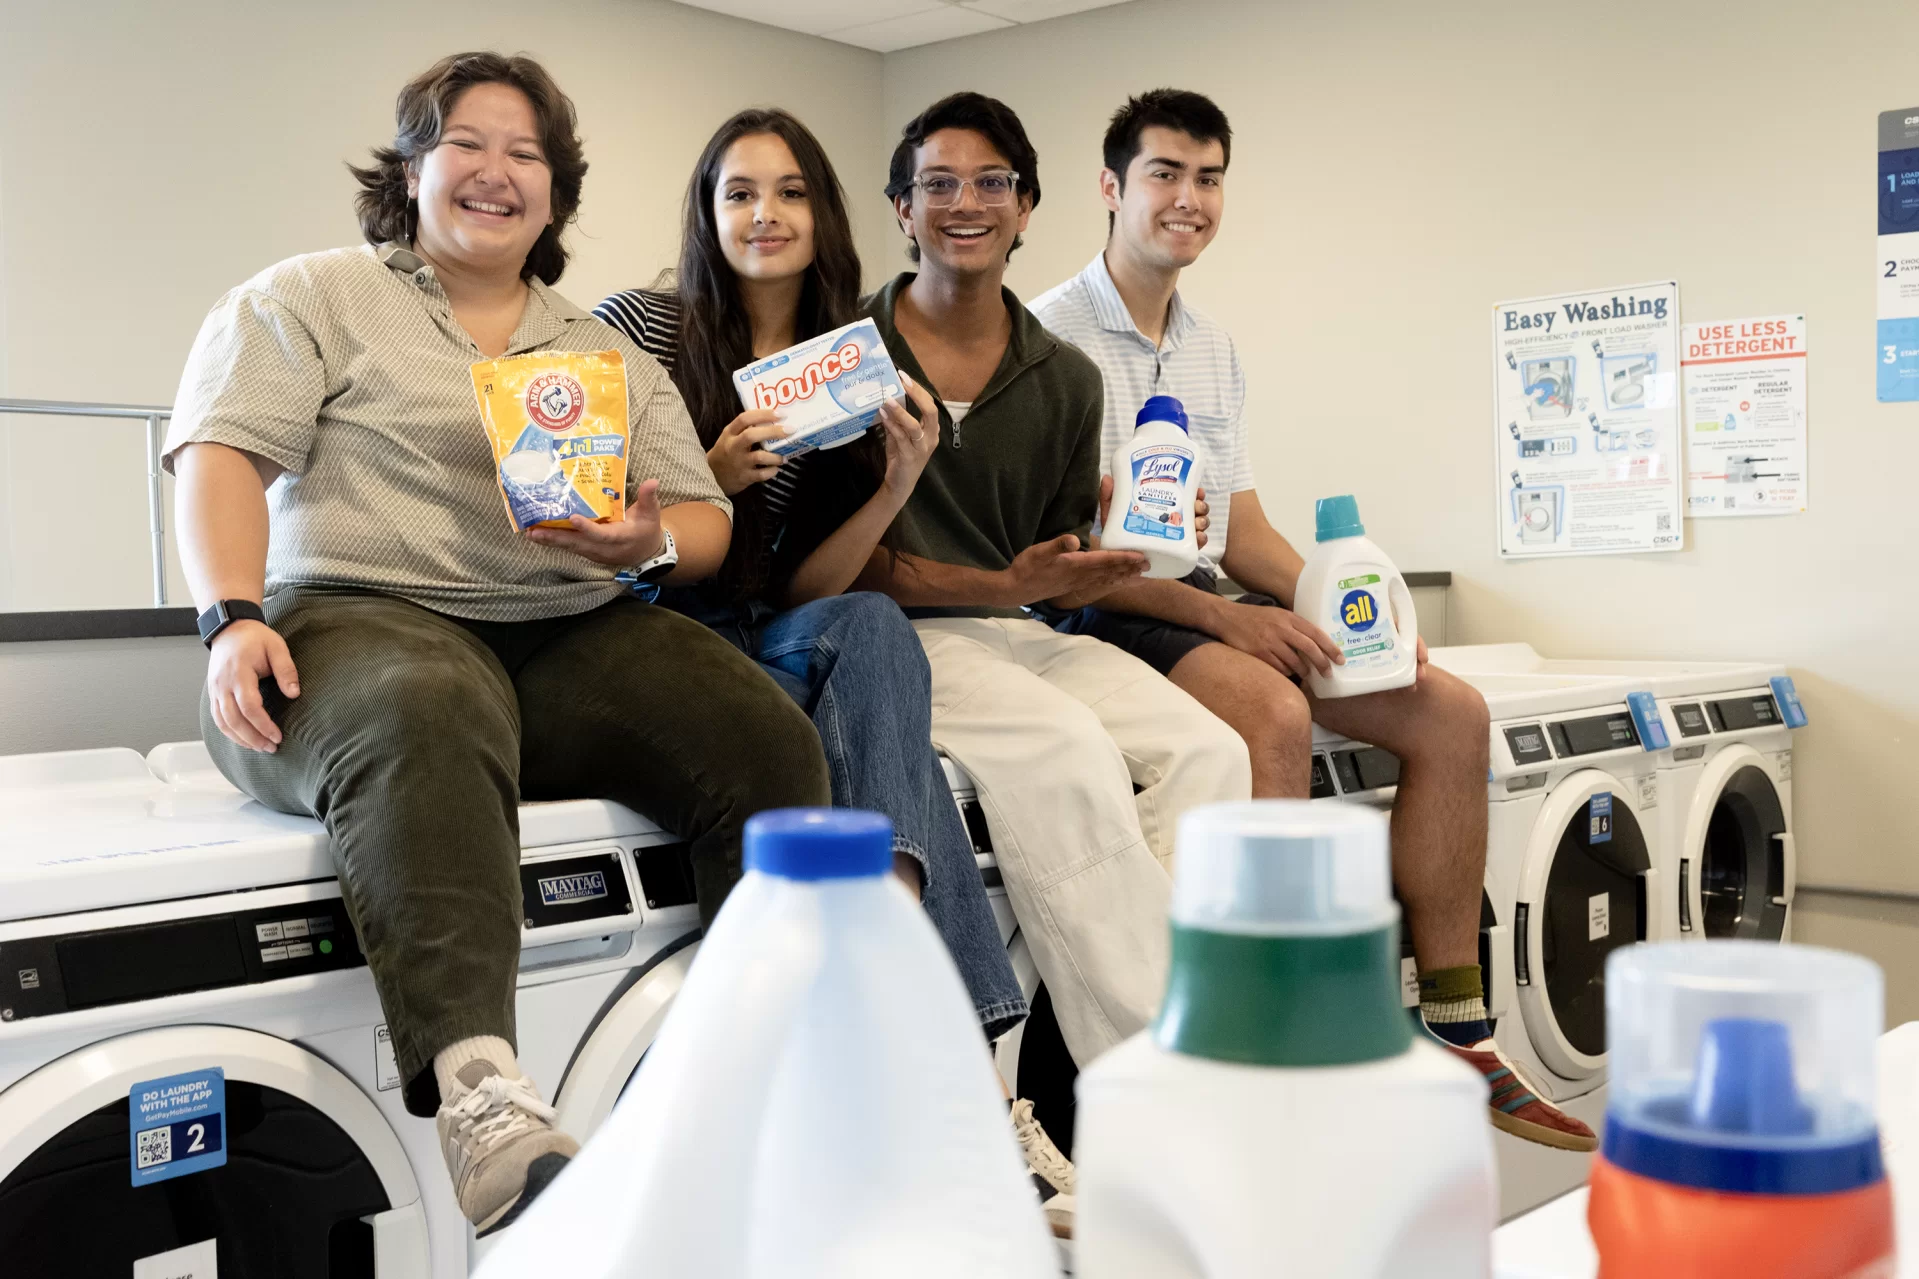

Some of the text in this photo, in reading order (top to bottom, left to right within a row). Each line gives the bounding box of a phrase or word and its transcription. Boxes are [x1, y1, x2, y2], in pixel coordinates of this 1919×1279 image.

[1887, 174, 1896, 192] 1
[1884, 260, 1897, 278] 2
[1504, 296, 1668, 333] Easy Washing
[1581, 321, 1668, 337] FRONT LOAD WASHER
[1698, 321, 1787, 341] USE LESS
[1690, 336, 1797, 357] DETERGENT
[1883, 345, 1897, 364] 3
[754, 343, 861, 411] bounce
[841, 374, 856, 384] free
[864, 362, 888, 376] gentle
[845, 380, 857, 391] pur
[865, 371, 885, 381] doux
[484, 384, 493, 393] 21
[530, 385, 543, 408] ARM
[548, 376, 581, 406] HAMMER
[1701, 385, 1738, 393] DETERGENT
[1143, 457, 1181, 478] Lysol
[1138, 491, 1177, 501] SANITIZER
[1142, 487, 1174, 496] LAUNDRY
[1345, 595, 1373, 625] all
[1347, 633, 1382, 645] free clear
[1601, 818, 1608, 832] 6
[542, 875, 602, 896] MAYTAG
[555, 889, 595, 900] COMMERCIAL
[143, 1080, 209, 1102] DO LAUNDRY
[140, 1090, 213, 1113] WITH THE APP
[145, 1103, 208, 1122] GetPayMobile.com
[187, 1123, 205, 1154] 2
